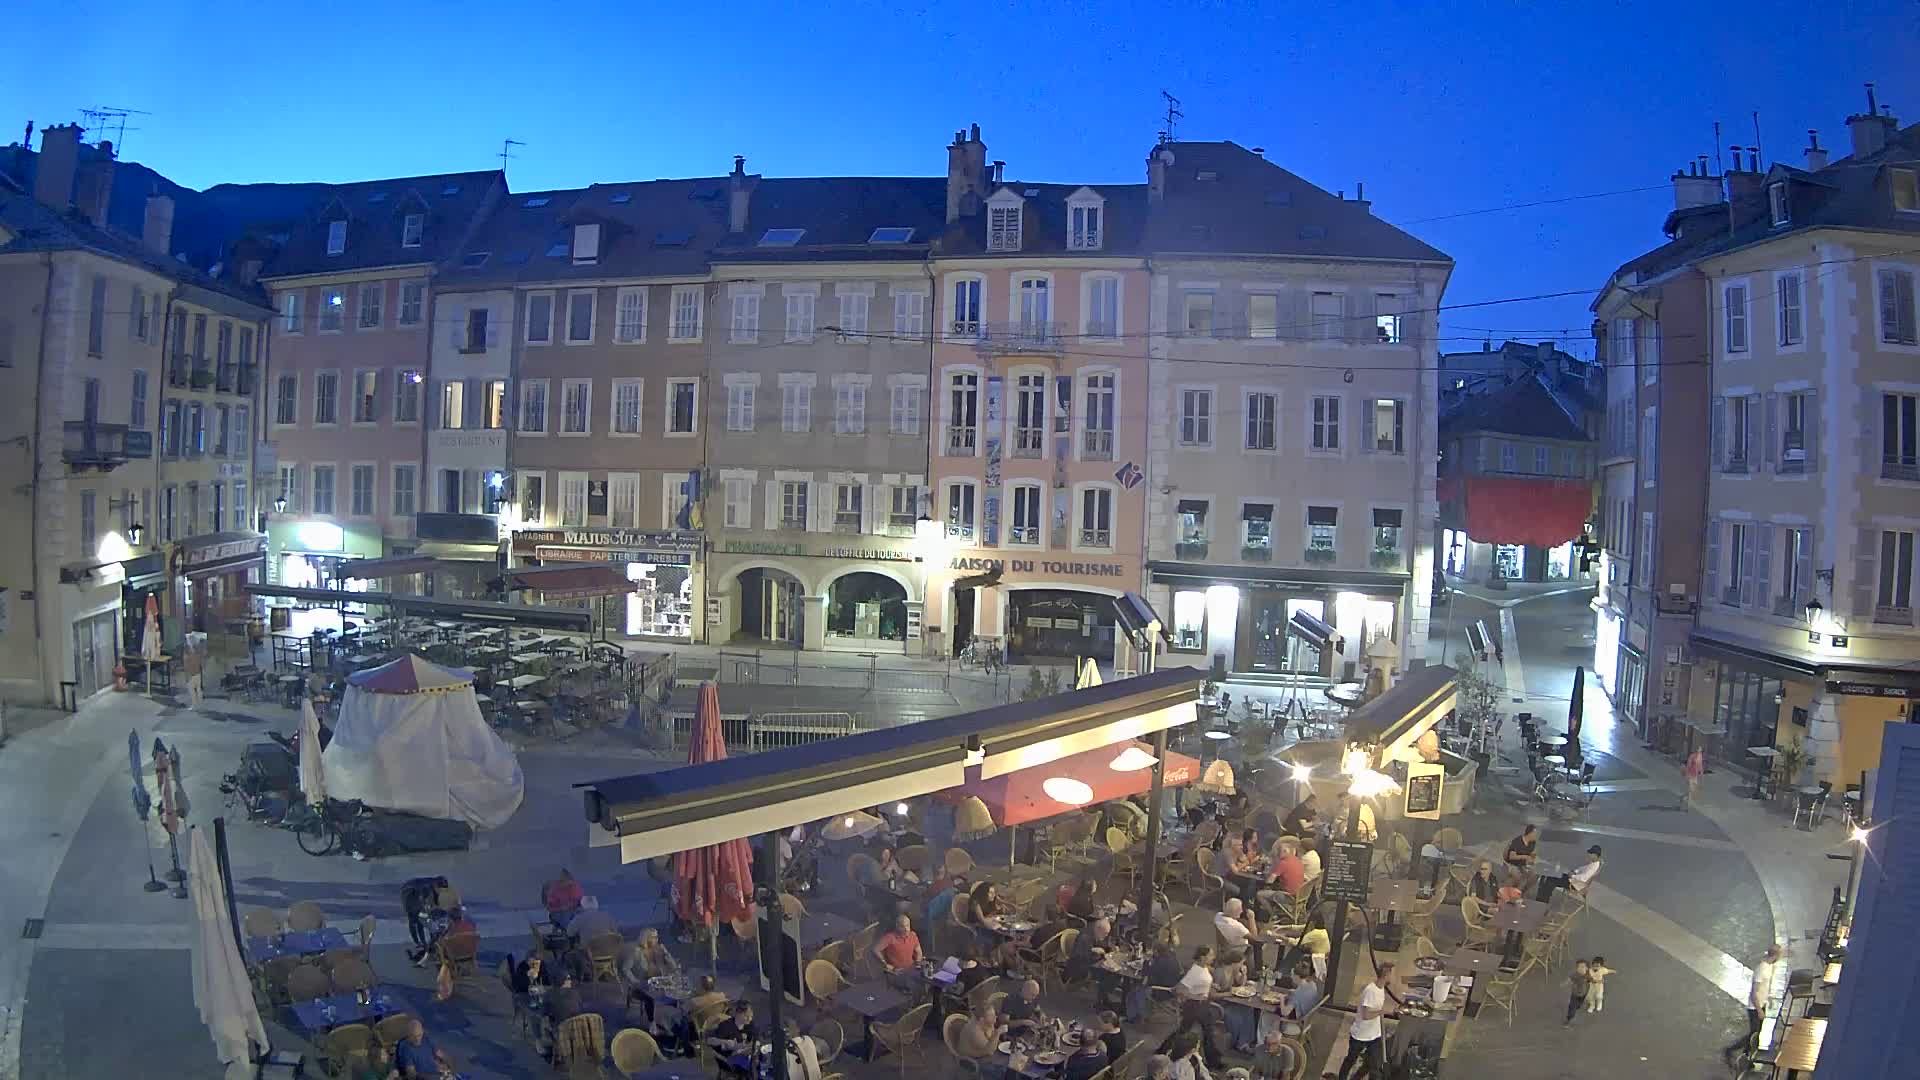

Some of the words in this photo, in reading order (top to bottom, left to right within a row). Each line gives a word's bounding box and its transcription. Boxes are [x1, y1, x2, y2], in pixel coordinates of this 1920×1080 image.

[563, 530, 647, 545] MAJUSCULE
[540, 550, 583, 559] LIBRAIRIE
[590, 552, 639, 561] PAPETERIE
[647, 554, 684, 563] PRESSE
[864, 549, 875, 559] DU
[1012, 560, 1034, 572] DU
[1042, 562, 1123, 577] TOURISME
